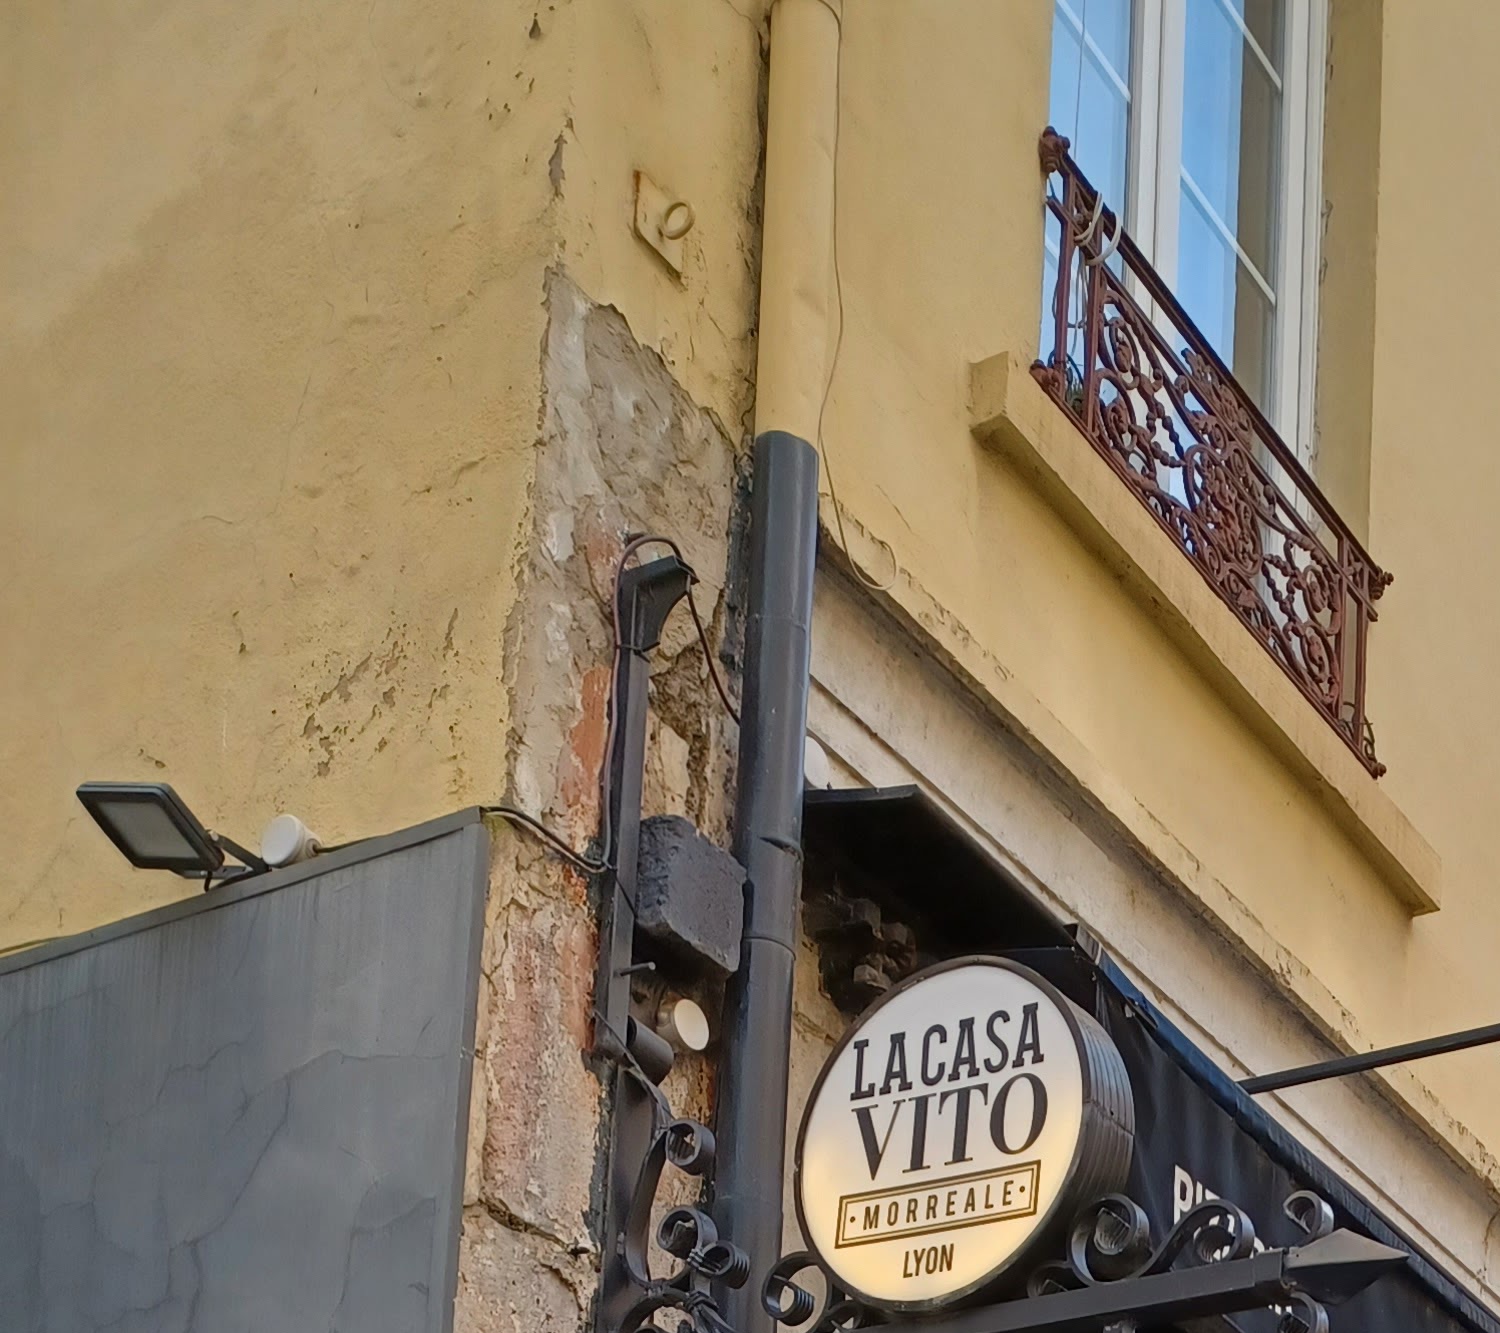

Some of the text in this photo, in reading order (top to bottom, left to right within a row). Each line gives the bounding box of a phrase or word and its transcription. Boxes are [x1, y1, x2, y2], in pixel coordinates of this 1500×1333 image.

[850, 1072, 1049, 1182] VITO
[862, 1179, 1015, 1231] MORREALE
[902, 1243, 955, 1279] LYON
